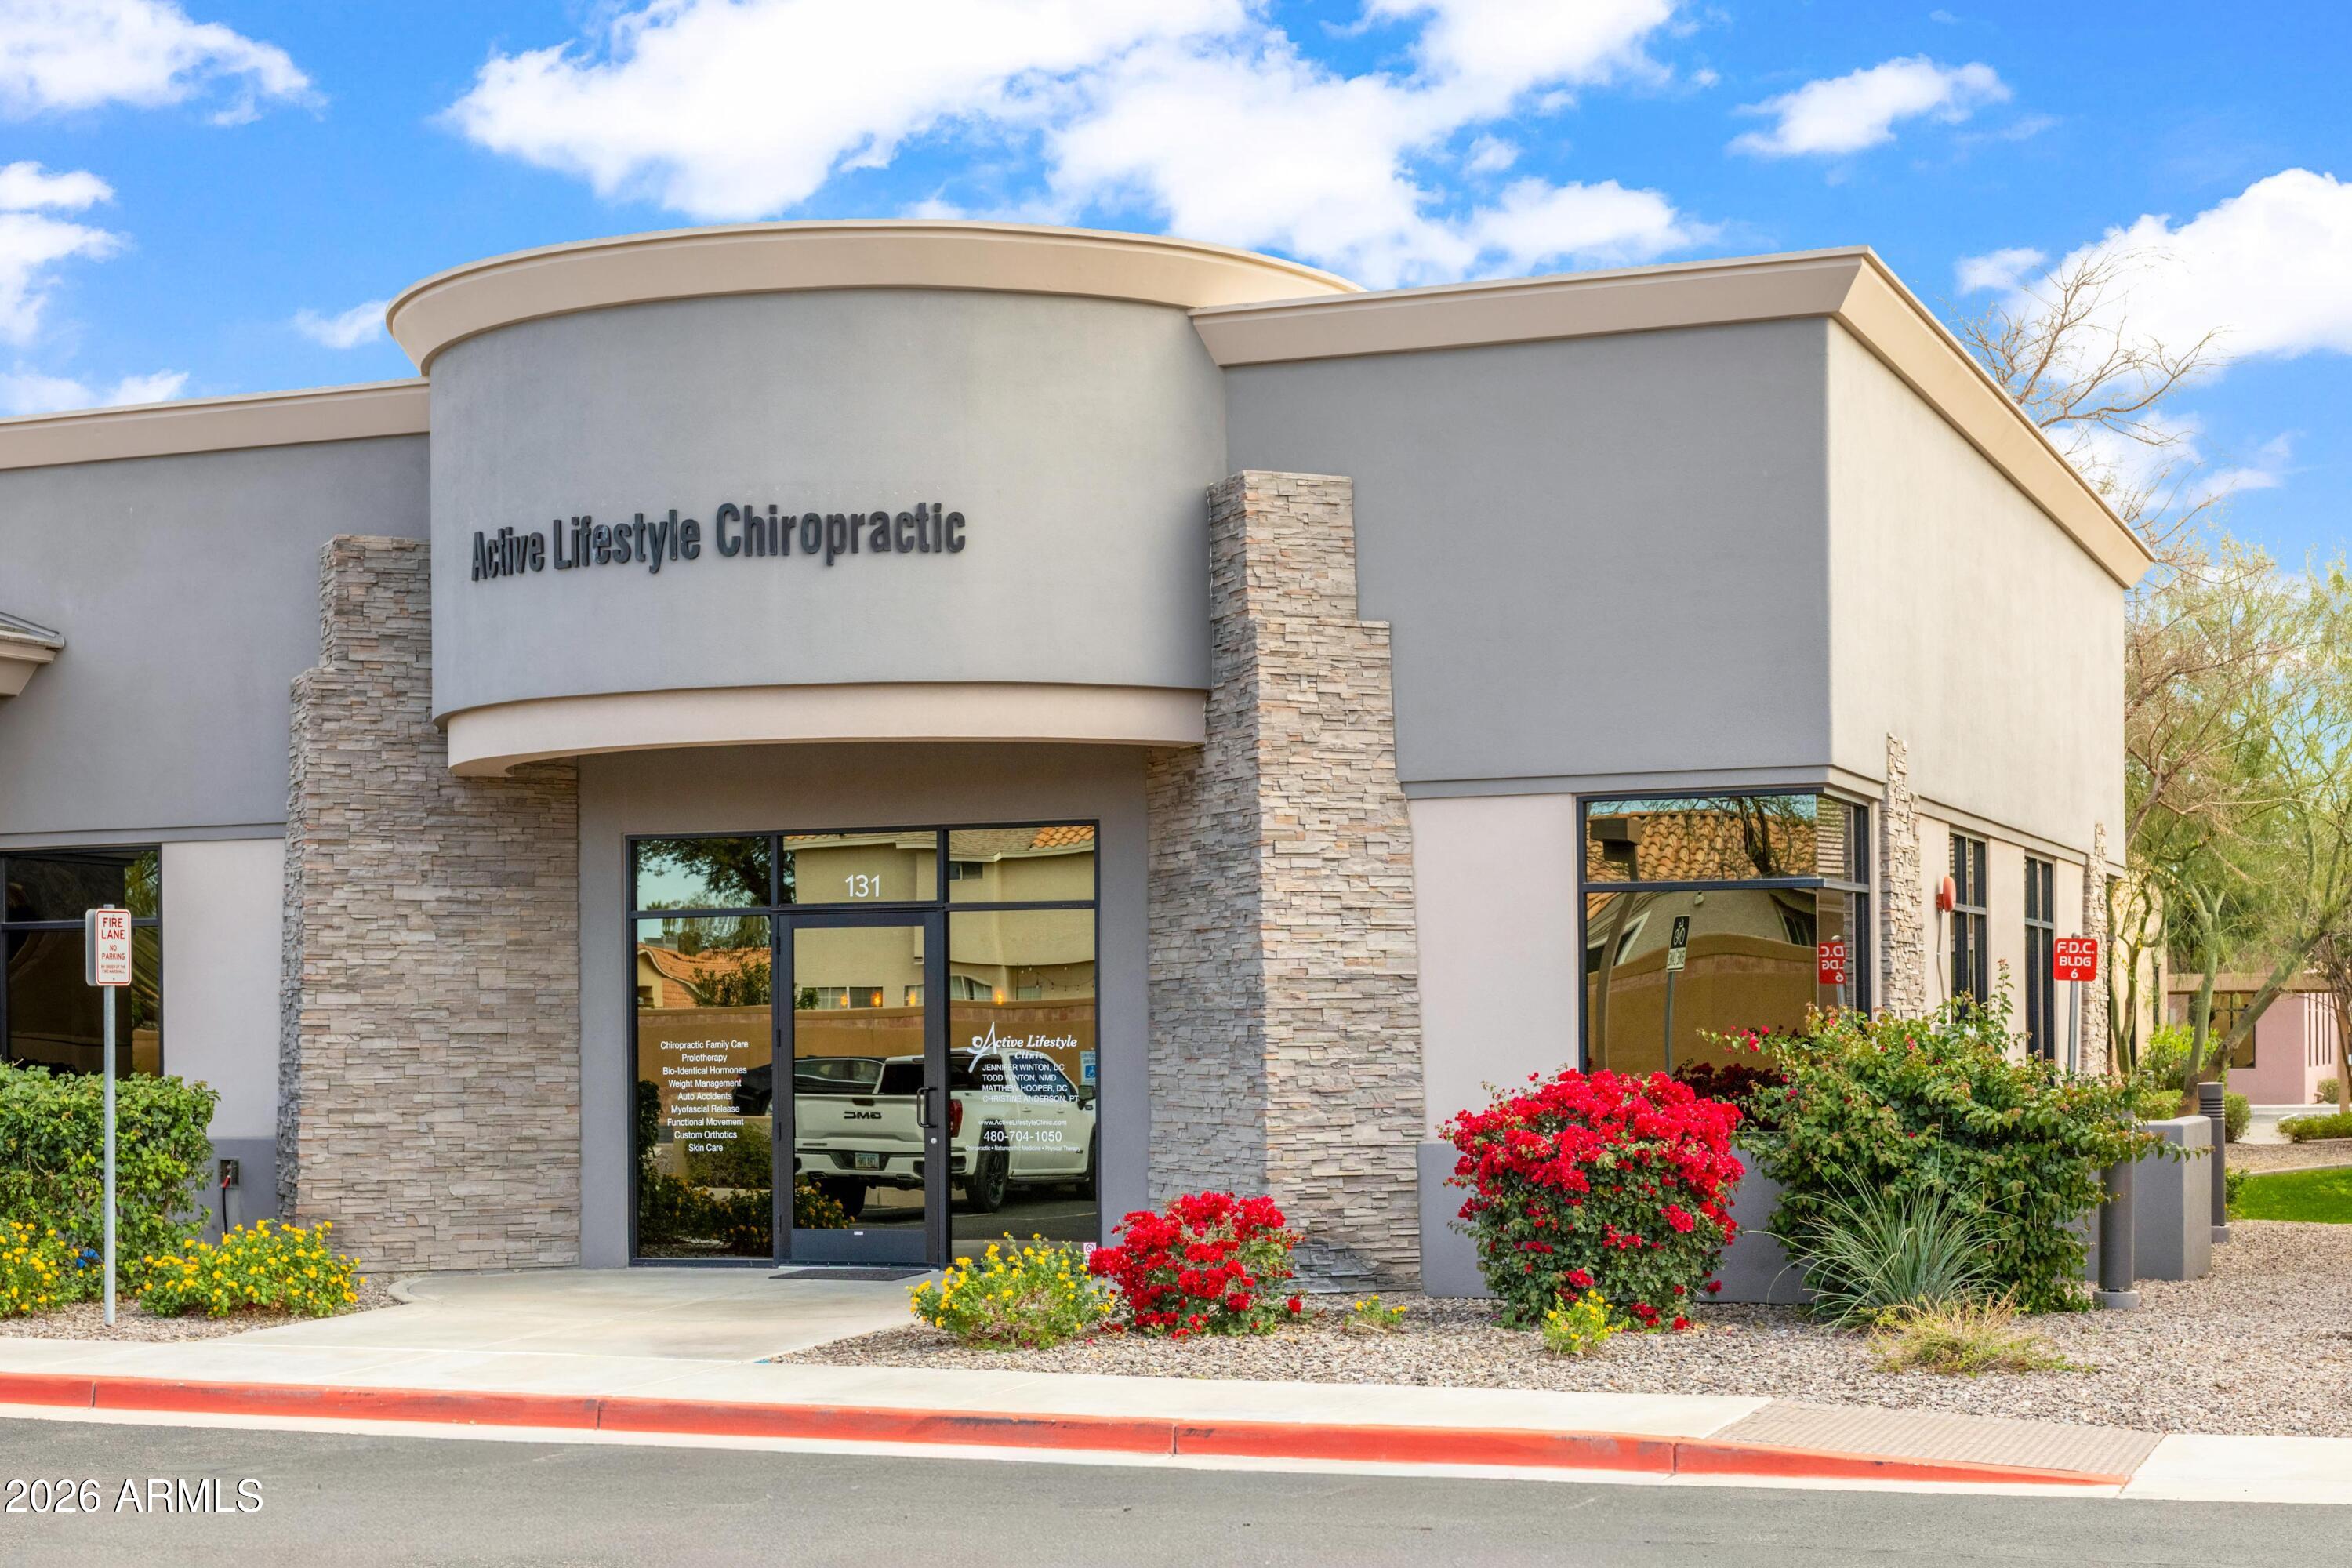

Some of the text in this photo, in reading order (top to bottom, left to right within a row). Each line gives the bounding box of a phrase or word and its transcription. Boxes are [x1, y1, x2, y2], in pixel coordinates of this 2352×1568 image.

[471, 502, 967, 581] Active Lifestyle Chiropractic
[845, 874, 880, 897] 131
[103, 917, 123, 927] FIRE
[101, 930, 125, 939] LANE
[2056, 942, 2095, 954] F.D.C.
[2059, 956, 2092, 967] BLDG
[2071, 968, 2079, 979] 6
[660, 1040, 749, 1051] Chiropractic Family Care
[1026, 1035, 1077, 1050] Lifestyle
[681, 1053, 728, 1063] Prolotherapy
[1014, 1051, 1044, 1059] Clinic
[662, 1066, 708, 1075] Bio-Identical
[982, 1063, 1065, 1073] JENNIFER WINTON, DC
[1004, 1074, 1037, 1083] WINTON,
[668, 1079, 742, 1089] Weight Management
[1020, 1084, 1055, 1093] HOOPER,
[677, 1092, 695, 1101] Auto
[1024, 1094, 1067, 1103] ANDERSON,
[670, 1105, 709, 1115] Myofascial
[667, 1117, 744, 1127] Functional Movement
[978, 1119, 1067, 1127] www.ActiveLifestyleClinic.com
[674, 1131, 702, 1139] Custom
[983, 1131, 1062, 1142] 480-704-1050
[688, 1143, 705, 1152] Skin
